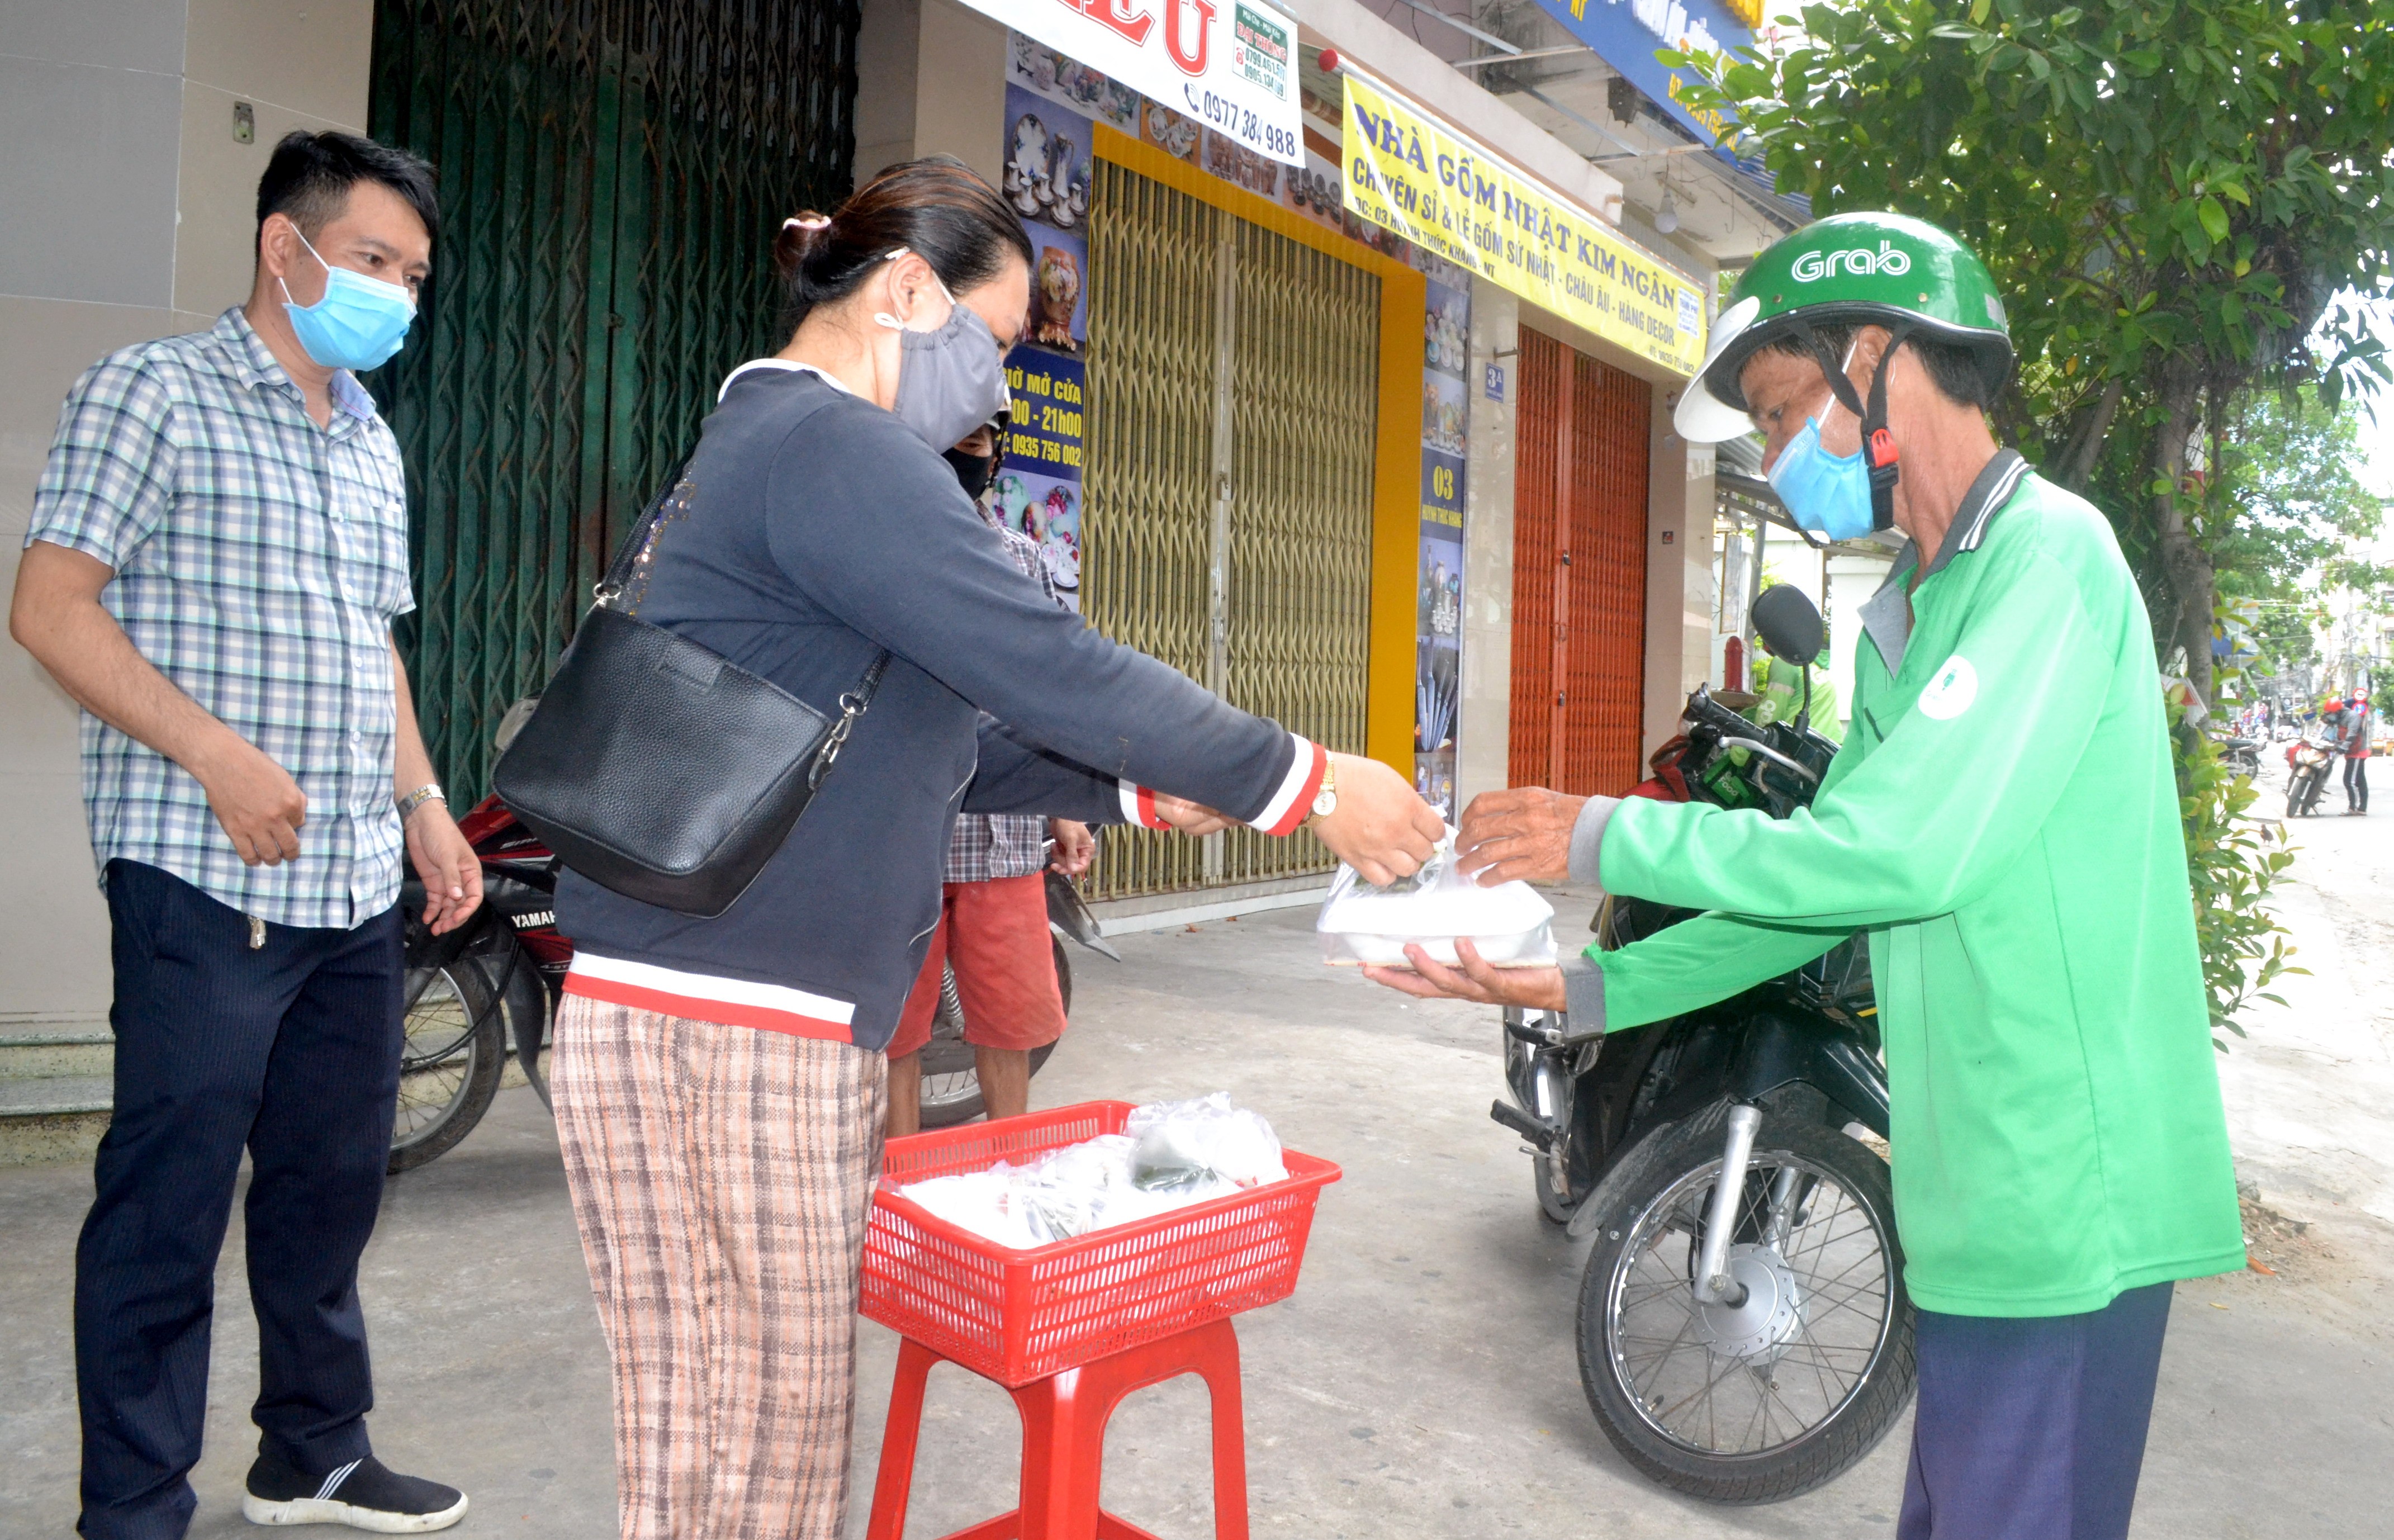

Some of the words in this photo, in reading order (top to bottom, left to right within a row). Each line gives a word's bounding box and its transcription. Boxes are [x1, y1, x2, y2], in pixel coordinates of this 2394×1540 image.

[1204, 91, 1238, 130] 0977
[1242, 110, 1263, 145] 384
[1266, 124, 1295, 157] 988
[1354, 103, 1428, 173] NHÀ
[1438, 154, 1496, 213] GỐM
[1504, 191, 1571, 253] NHẬT
[1577, 234, 1616, 280] KIM
[1622, 260, 1675, 312] NGÂN
[1375, 206, 1388, 225] 03
[1423, 230, 1446, 254] THÚC
[1442, 205, 1452, 231] &
[1474, 221, 1502, 258] GỐM
[1527, 250, 1555, 287] NHẬT
[1566, 272, 1594, 306] CHÂU
[1597, 287, 1610, 314] ÂU
[1619, 300, 1644, 331] HÀNG
[1647, 315, 1675, 347] DECOR
[1791, 239, 1911, 282] Grab
[1003, 366, 1024, 390] IỜ
[1026, 372, 1051, 396] MỞ
[1054, 378, 1082, 405] CỬA
[1487, 368, 1502, 388] 3A
[1042, 405, 1082, 438] 21h00
[1012, 433, 1039, 458] 0935
[1041, 439, 1060, 463] 756
[1063, 444, 1082, 467] 002
[1433, 465, 1453, 500] 03
[511, 910, 555, 928] YAMAH
